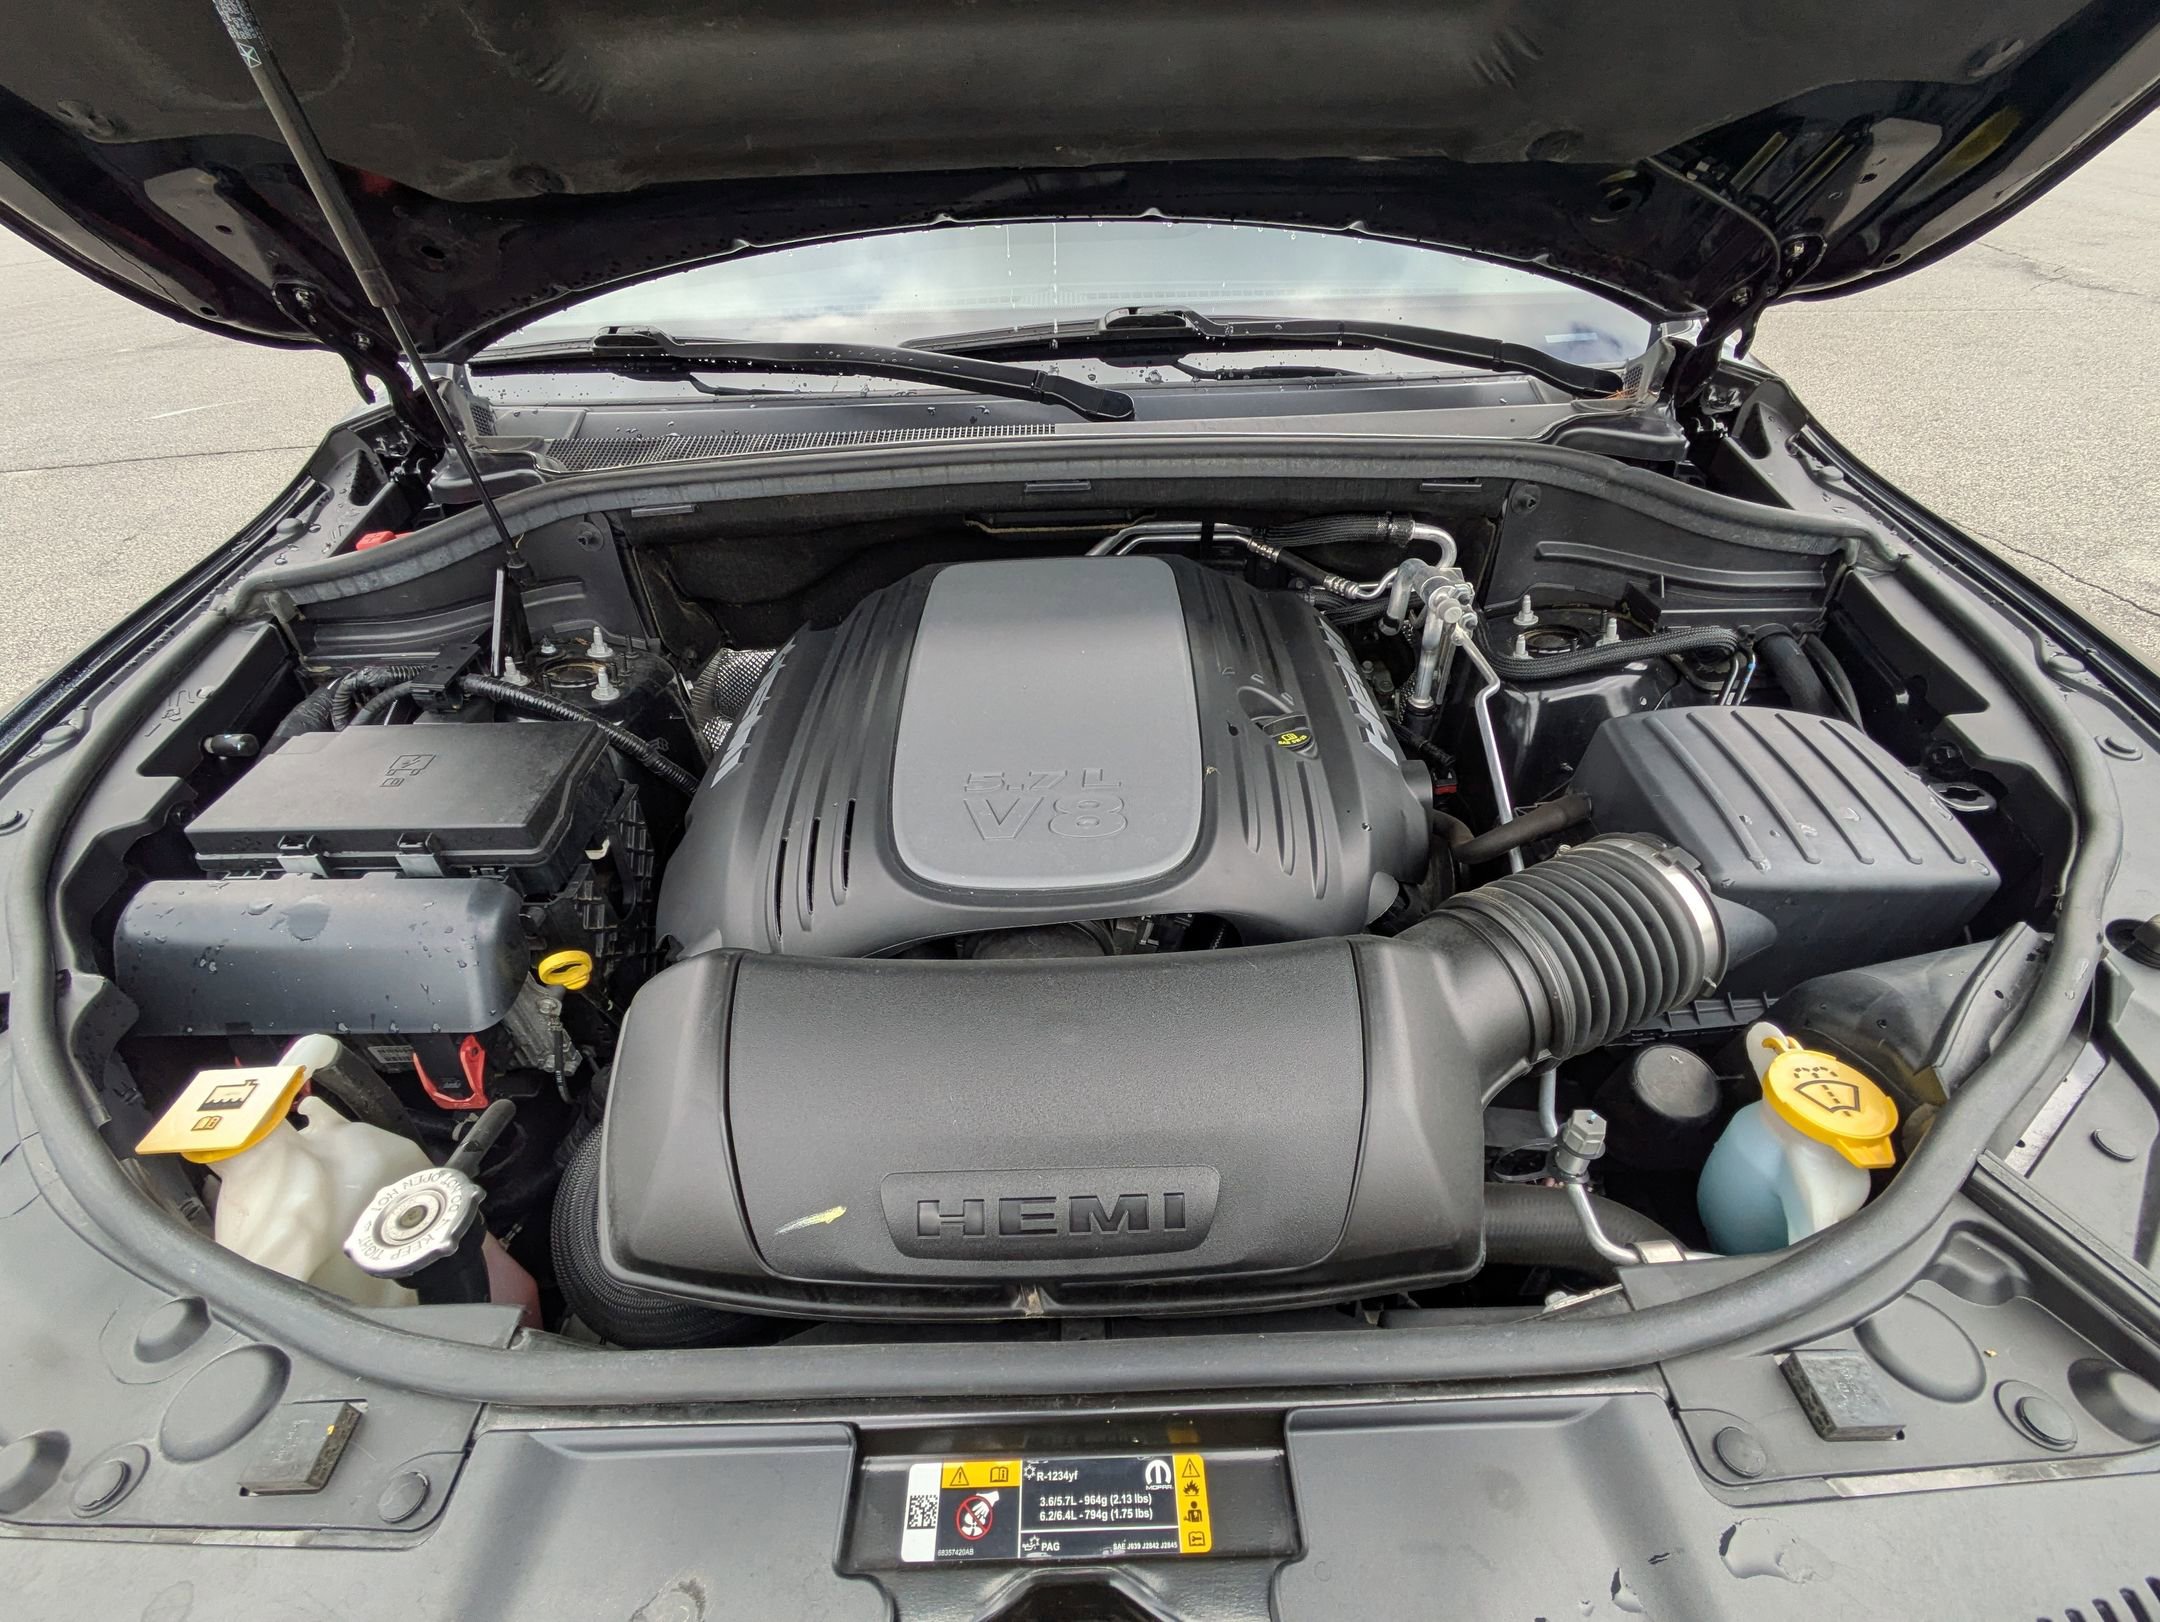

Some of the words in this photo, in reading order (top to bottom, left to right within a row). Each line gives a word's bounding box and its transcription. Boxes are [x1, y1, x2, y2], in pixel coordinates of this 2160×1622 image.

[963, 796, 1129, 841] V8
[402, 1173, 441, 1191] OPEN
[441, 1172, 463, 1194] NOT
[371, 1188, 399, 1212] HOT
[448, 1195, 463, 1212] DO
[916, 1192, 1188, 1240] HEMI
[358, 1237, 384, 1261] TIGHT
[389, 1234, 434, 1260] KEEP
[1036, 1470, 1079, 1483] R-1234yf
[1039, 1496, 1077, 1507] 3.6/5.7L
[1084, 1495, 1107, 1507] 964g
[1110, 1494, 1133, 1507] (2.13
[1134, 1493, 1152, 1506] lbs)
[1039, 1510, 1077, 1522] 6.2/6.4L
[1085, 1509, 1108, 1522] 794g
[1110, 1509, 1133, 1521] (1.75
[1135, 1508, 1153, 1520] lbs)
[1041, 1542, 1061, 1552] PAG
[1112, 1542, 1126, 1550] SAE
